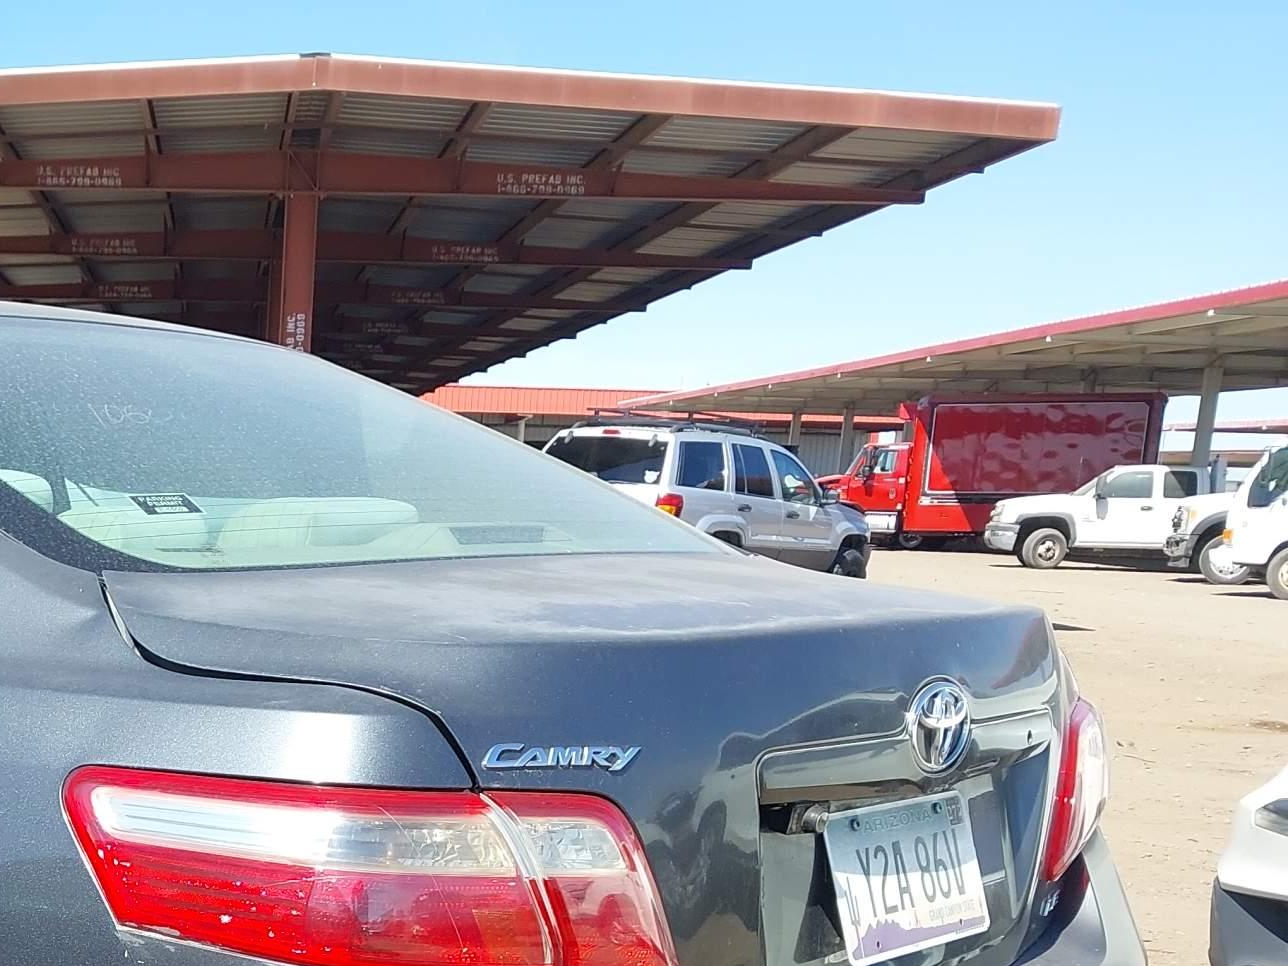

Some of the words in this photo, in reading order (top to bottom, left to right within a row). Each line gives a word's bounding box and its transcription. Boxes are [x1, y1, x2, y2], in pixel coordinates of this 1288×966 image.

[496, 173, 516, 184] U.S.
[521, 173, 562, 185] PREFAB
[481, 742, 642, 771] CAMRY
[863, 809, 931, 833] ARIZONA
[856, 839, 916, 918] Y2A
[913, 829, 966, 903] 86V
